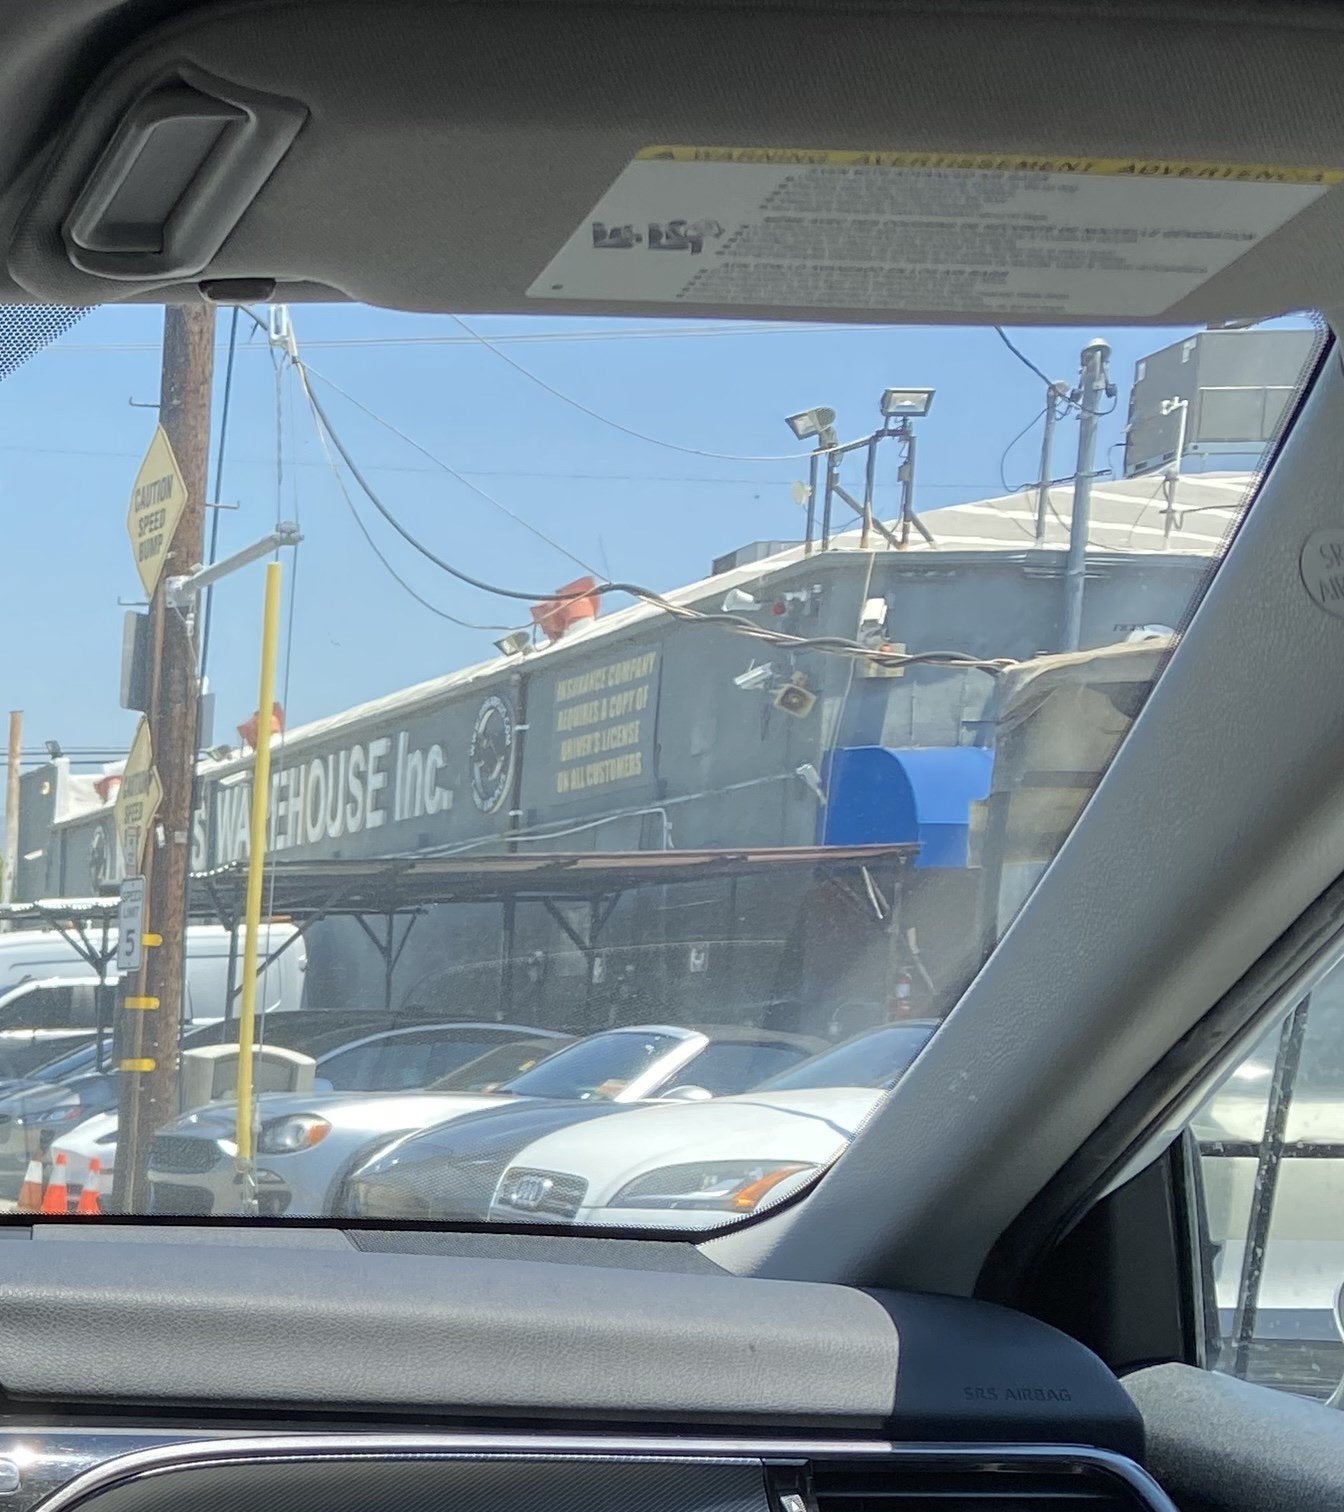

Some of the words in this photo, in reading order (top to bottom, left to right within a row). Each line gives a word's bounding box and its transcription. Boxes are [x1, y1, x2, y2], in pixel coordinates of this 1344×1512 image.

[134, 474, 174, 513] CAUTION
[138, 507, 166, 538] SPEED
[216, 735, 392, 864] WAEHOUSE
[394, 730, 454, 821] Inc.
[125, 928, 135, 957] 5
[962, 1386, 998, 1401] SRS
[1005, 1387, 1072, 1402] AIRBAG
